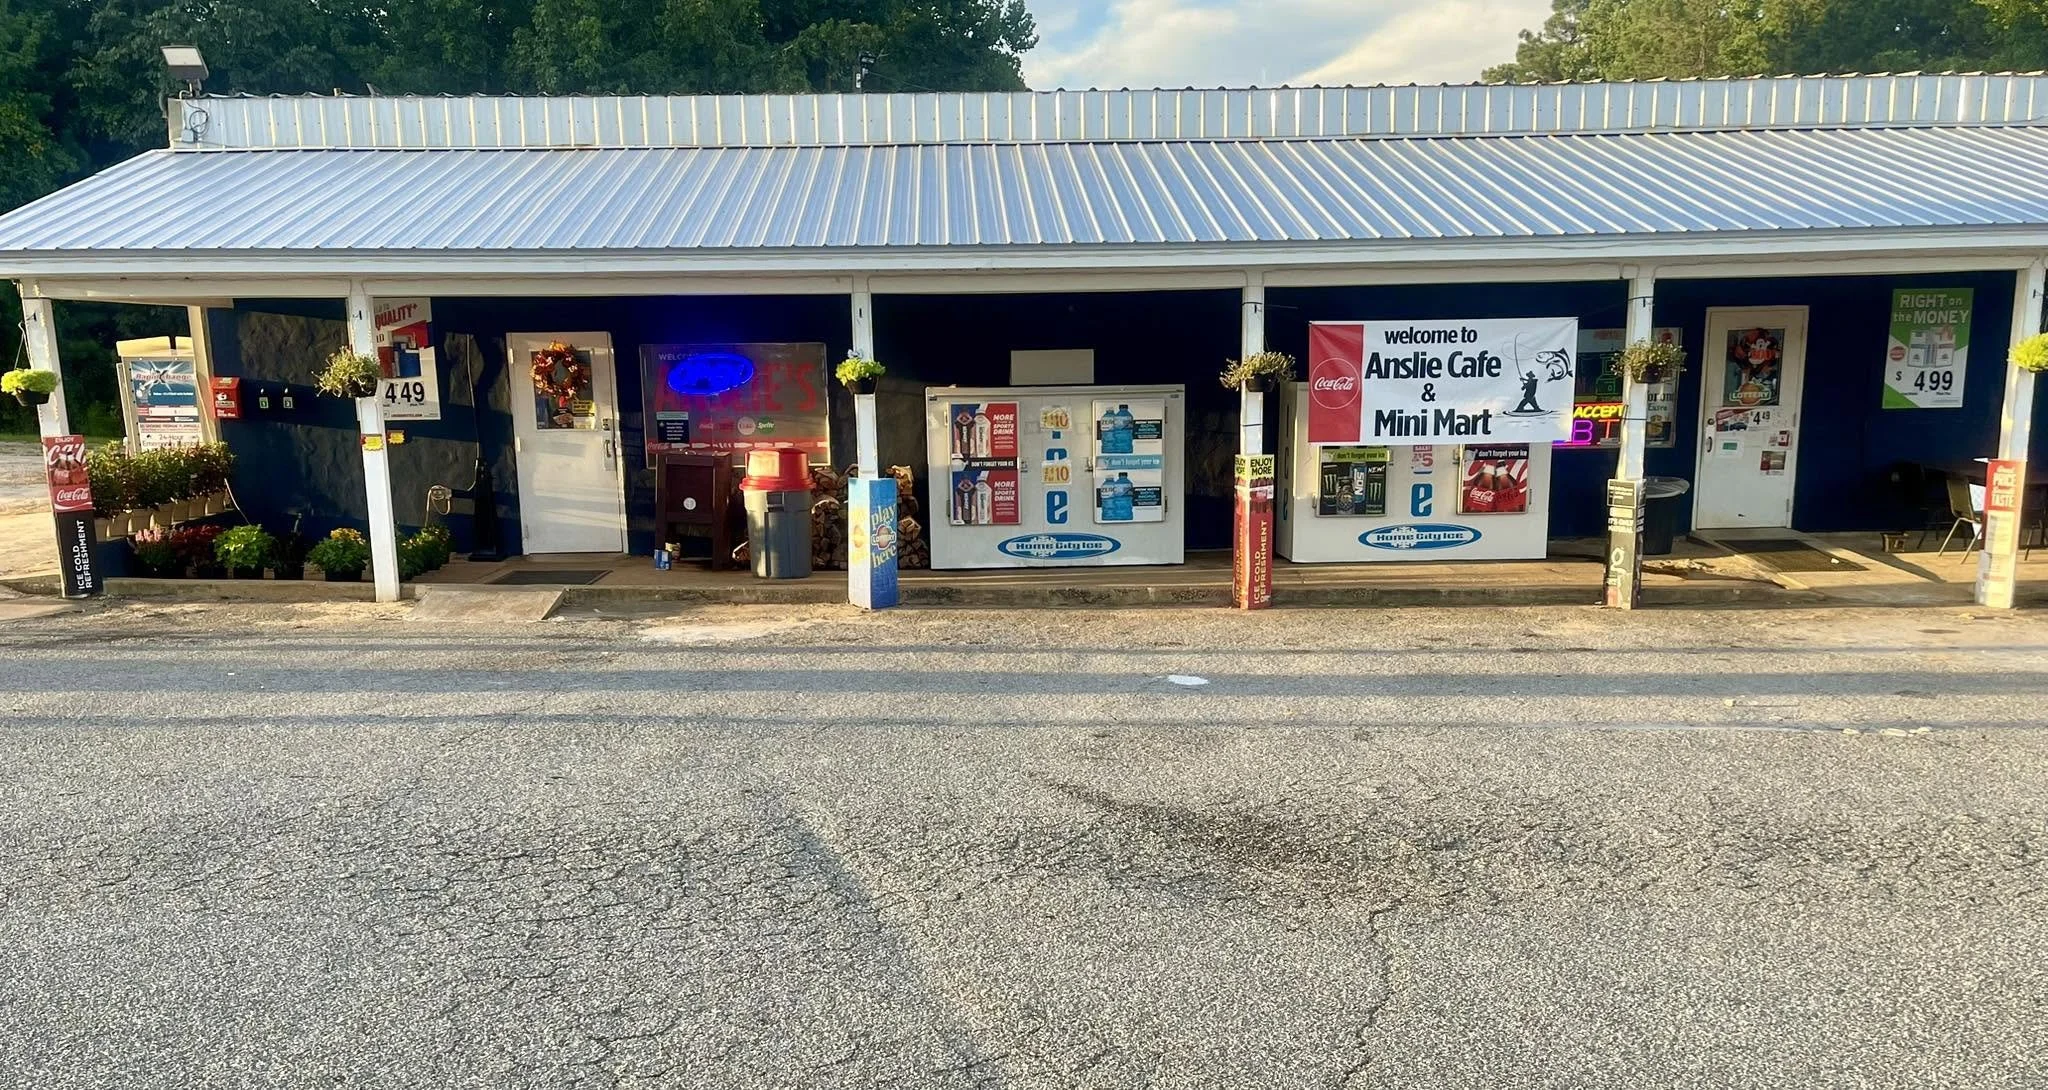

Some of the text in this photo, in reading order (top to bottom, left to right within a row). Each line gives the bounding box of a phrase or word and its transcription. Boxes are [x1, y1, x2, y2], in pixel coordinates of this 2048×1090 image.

[1900, 294, 1962, 308] RIGHT on
[1893, 310, 1969, 324] the MONEY
[1385, 326, 1478, 345] welcome to
[658, 353, 699, 361] WELC
[1365, 350, 1501, 379] Anslie Cafe
[1421, 383, 1436, 402] &
[1732, 391, 1769, 399] LOTTERY
[1573, 405, 1624, 418] ACCEPT
[1374, 409, 1492, 437] Mini Mart
[1572, 419, 1620, 443] BT
[1250, 458, 1273, 467] ENJOY
[1252, 466, 1272, 476] MORE
[870, 504, 896, 530] play
[1055, 542, 1080, 550] City
[1082, 541, 1103, 549] Ice
[1416, 532, 1441, 541] City
[76, 519, 93, 589] REFRESHMENT
[871, 545, 897, 568] here
[1260, 520, 1268, 603] REFRESHMENT
[72, 545, 86, 589] ICE COLD
[1254, 583, 1262, 604] ICE
